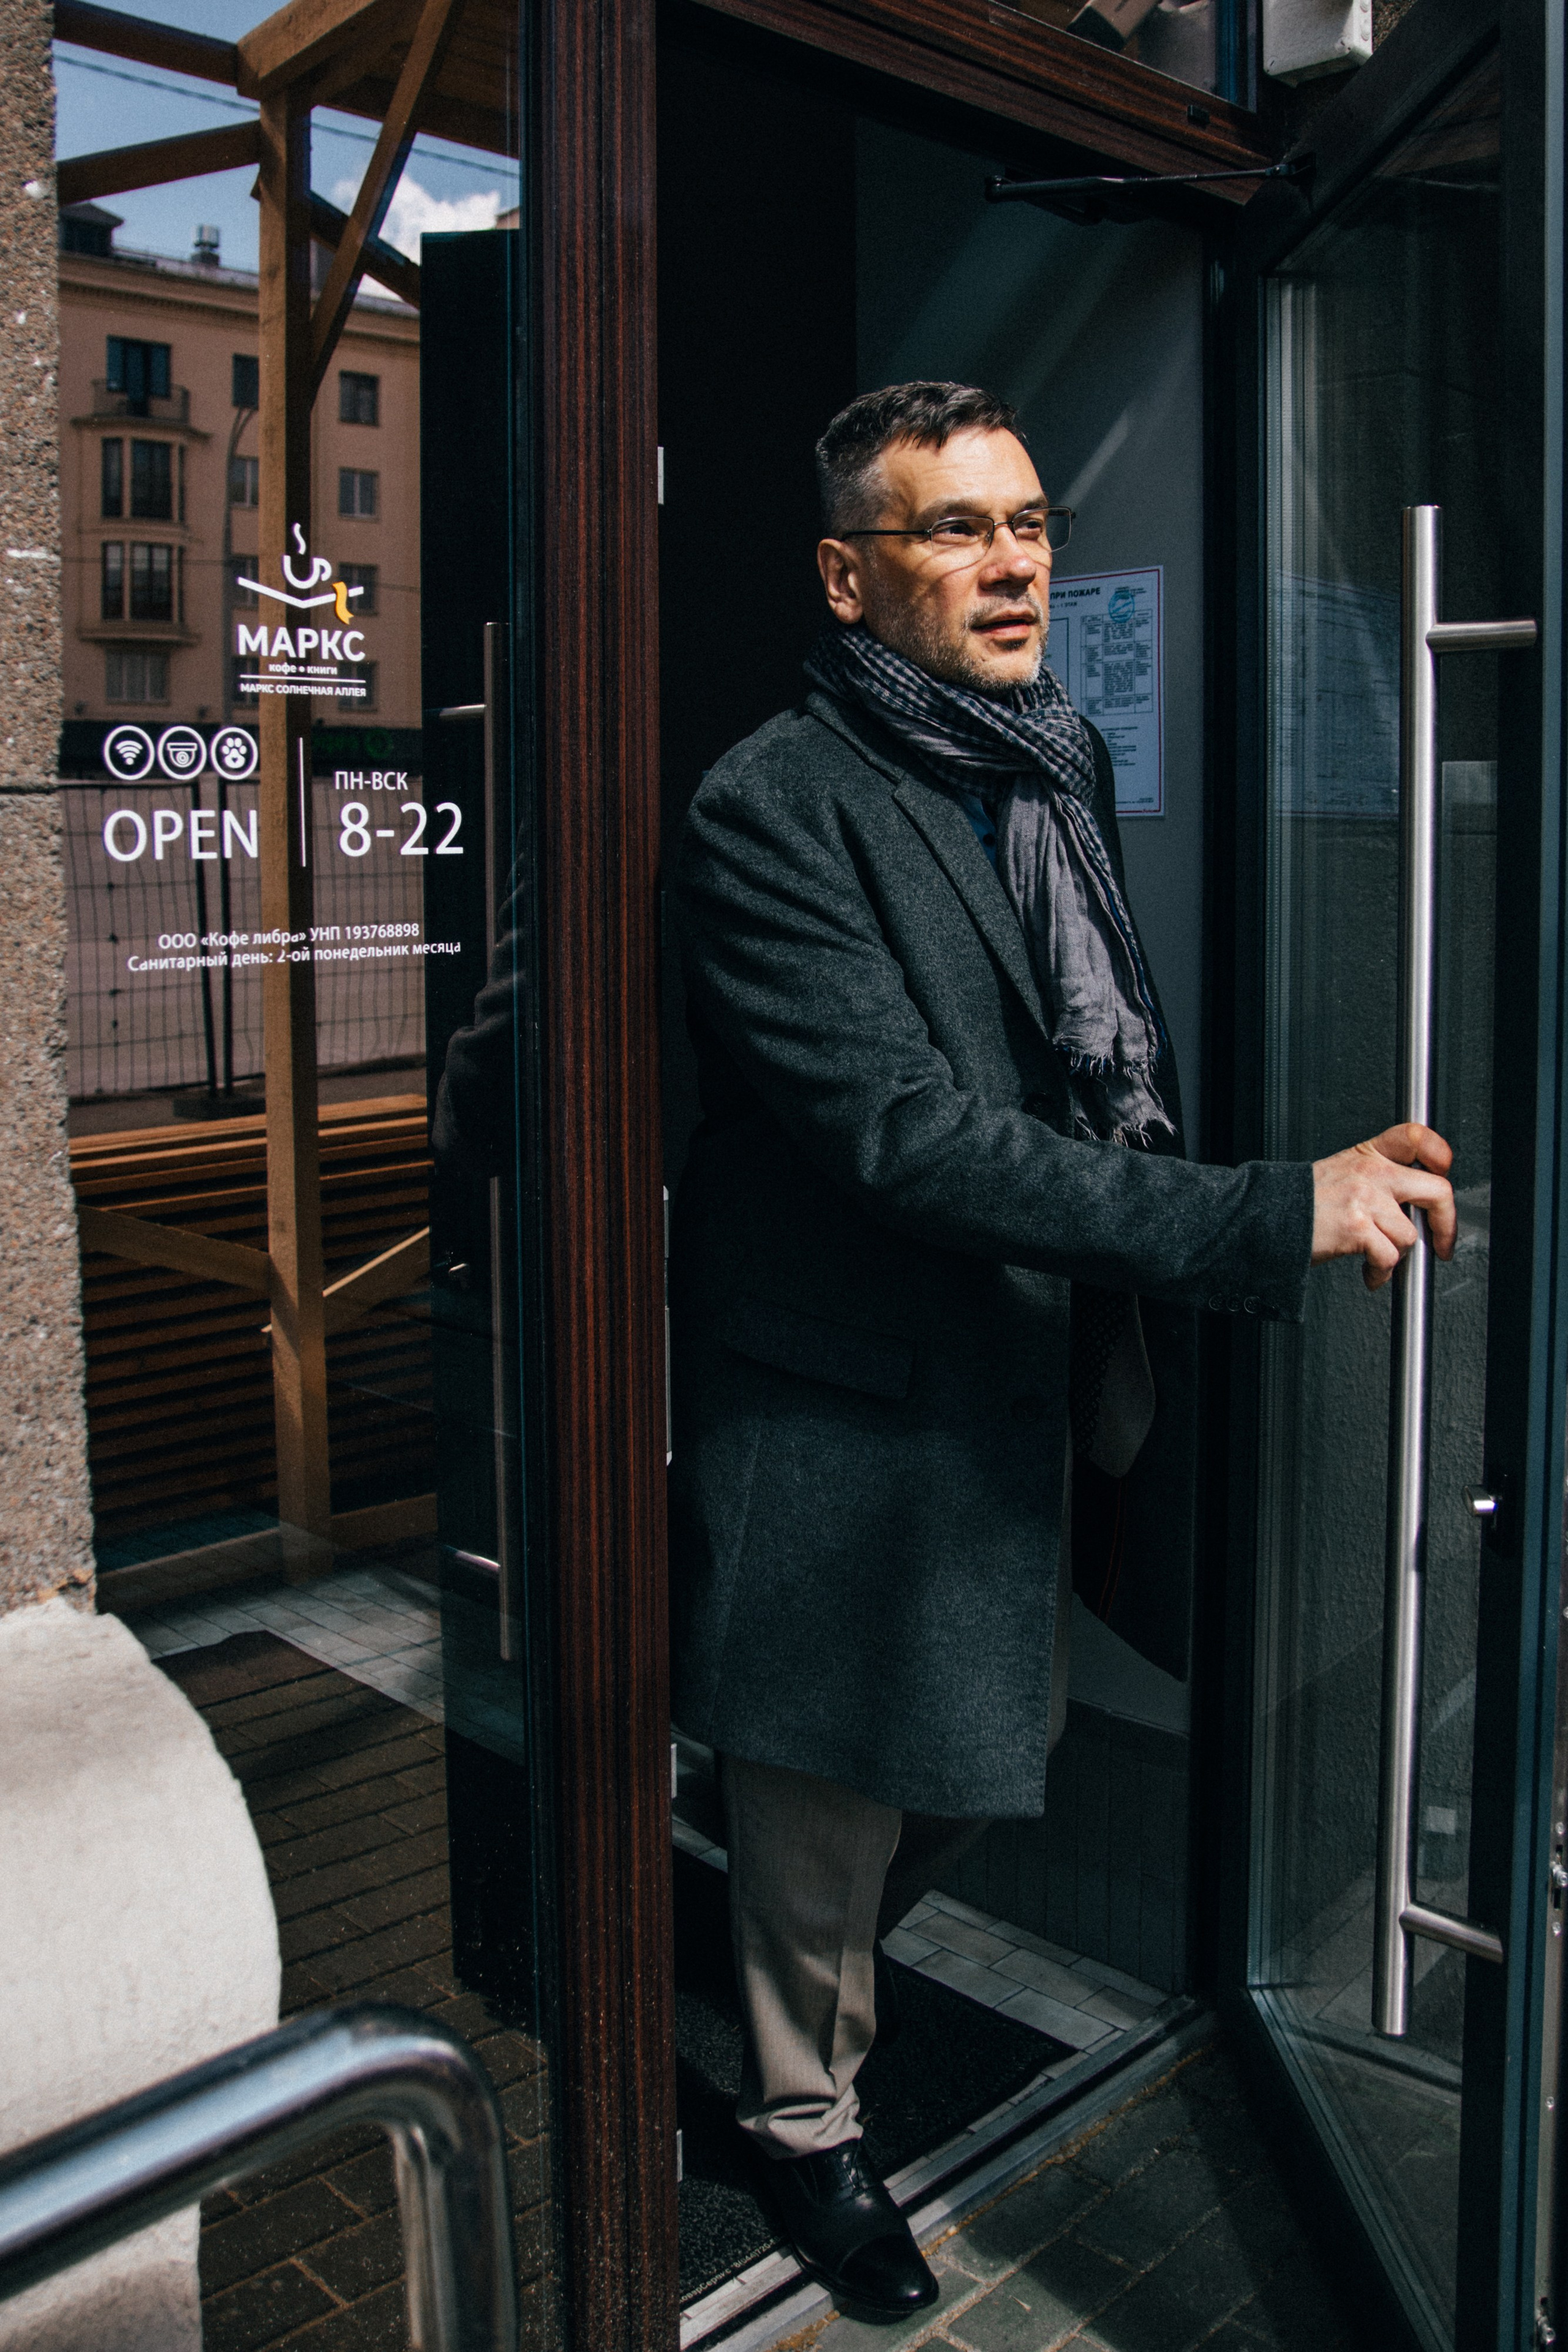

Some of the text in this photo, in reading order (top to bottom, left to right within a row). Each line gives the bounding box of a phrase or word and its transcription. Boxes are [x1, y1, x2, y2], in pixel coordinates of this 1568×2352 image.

[1069, 587, 1101, 597] ПОЖАРЕ
[238, 624, 366, 662] МАРКС
[268, 662, 338, 675] кофе книги
[240, 683, 366, 697] МАРКС СОЛНЕЧНАЯ АЛЛЕЯ
[335, 771, 409, 791] ПН-ВСК
[104, 809, 258, 862] OPEN
[339, 802, 464, 858] 8-22
[158, 922, 420, 950] ООО «Кофе либра» УНП 193768898
[127, 942, 461, 972] Санитарный день: 2-ой понедельник месяца
